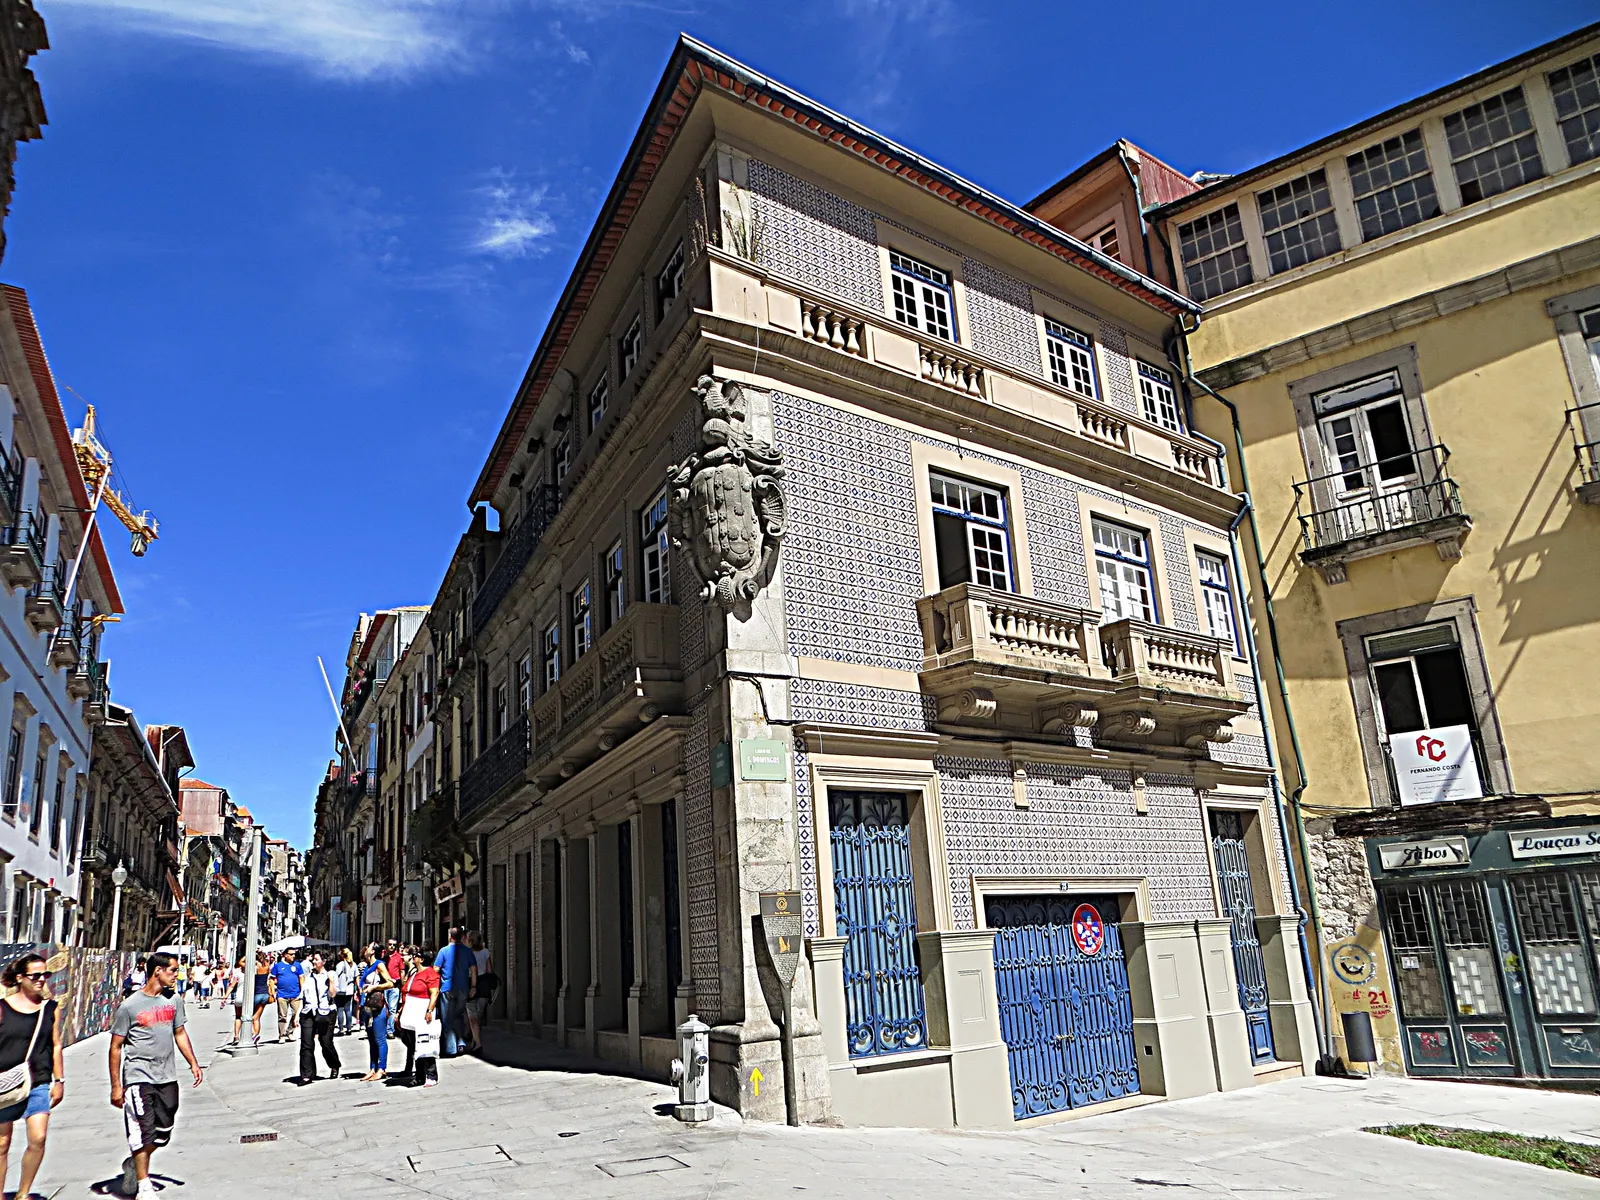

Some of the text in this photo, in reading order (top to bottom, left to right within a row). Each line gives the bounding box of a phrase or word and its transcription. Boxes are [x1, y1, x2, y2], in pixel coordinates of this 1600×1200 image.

[1410, 766, 1441, 774] FERNANDO
[1518, 837, 1581, 852] Louças
[1367, 990, 1388, 1005] 21
